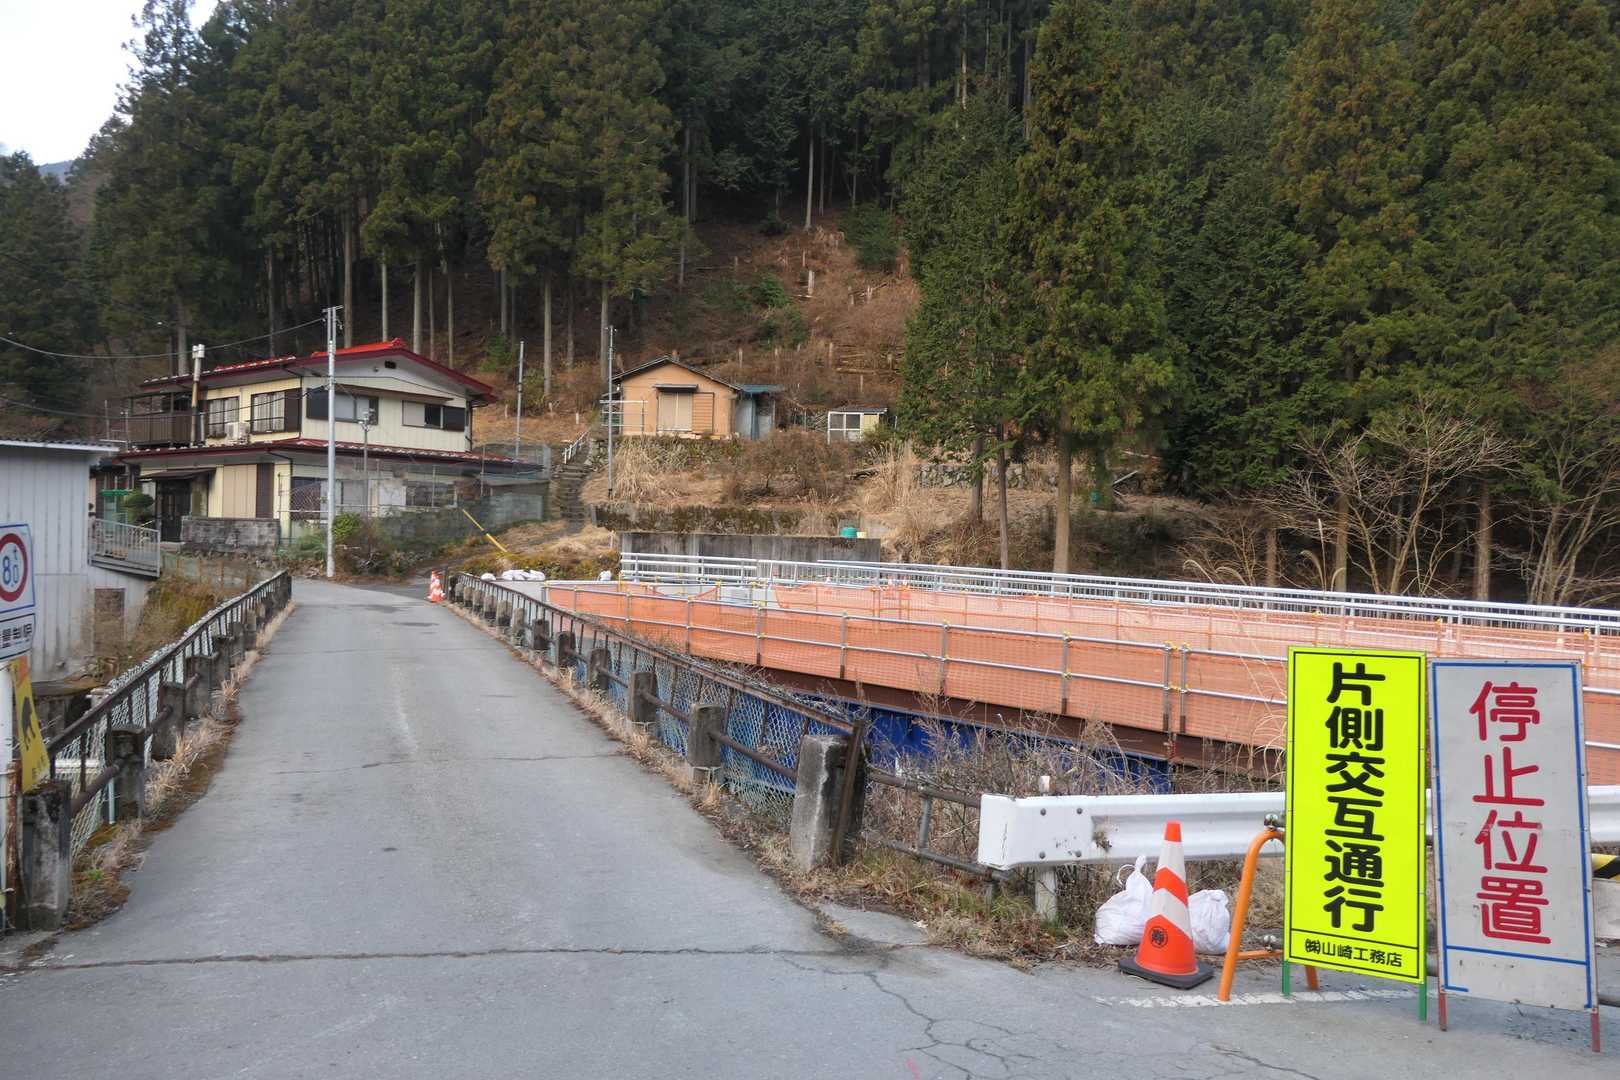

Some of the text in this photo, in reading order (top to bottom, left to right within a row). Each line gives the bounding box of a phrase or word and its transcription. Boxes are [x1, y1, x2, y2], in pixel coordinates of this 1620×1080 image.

[1323, 662, 1385, 932] 片側交互通行
[1469, 681, 1551, 945] 停止位置
